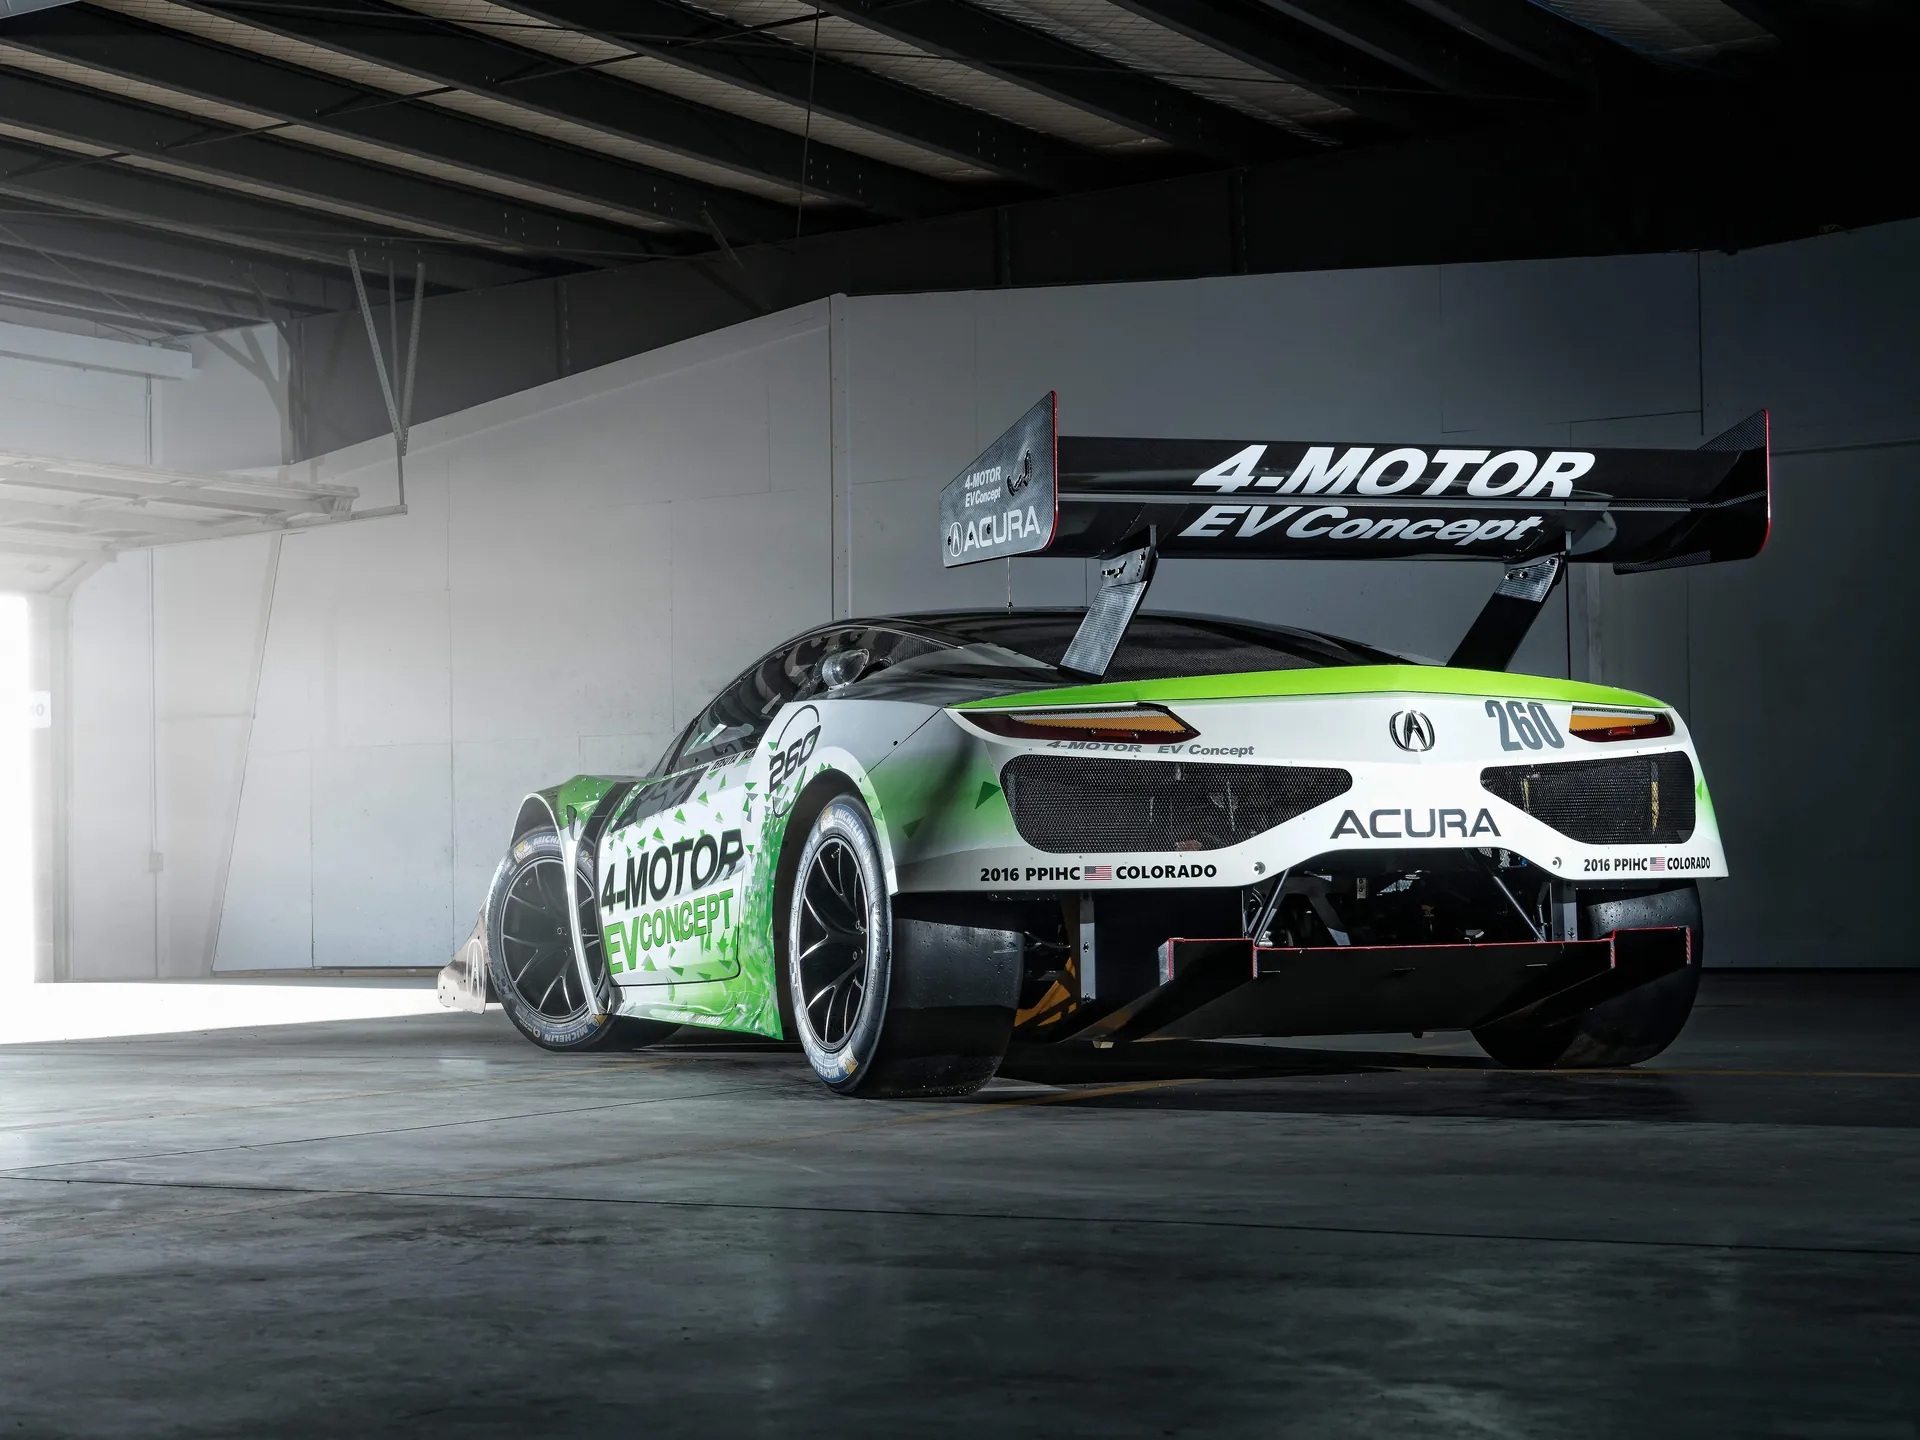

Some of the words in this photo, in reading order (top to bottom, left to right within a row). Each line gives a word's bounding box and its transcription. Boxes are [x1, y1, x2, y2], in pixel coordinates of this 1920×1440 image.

[965, 466, 1001, 489] 4-MOTOR
[1191, 444, 1596, 498] 4-MOTOR
[964, 506, 1040, 552] ACURA
[1485, 700, 1565, 751] 260
[769, 725, 821, 793] 260
[1046, 740, 1142, 753] 4-MOTOR
[1157, 744, 1184, 755] EV
[1188, 744, 1254, 758] Concept
[1330, 808, 1502, 839] ACURA
[601, 829, 744, 917] 4-MOTOR
[980, 867, 1020, 882] 2016
[1025, 866, 1081, 882] PPIHC
[1116, 864, 1218, 880] COLORADO
[1583, 858, 1610, 872] 2016
[1614, 858, 1648, 872] PPIHC
[1667, 856, 1711, 870] COLORADO
[544, 1026, 589, 1043] MICHELIN
